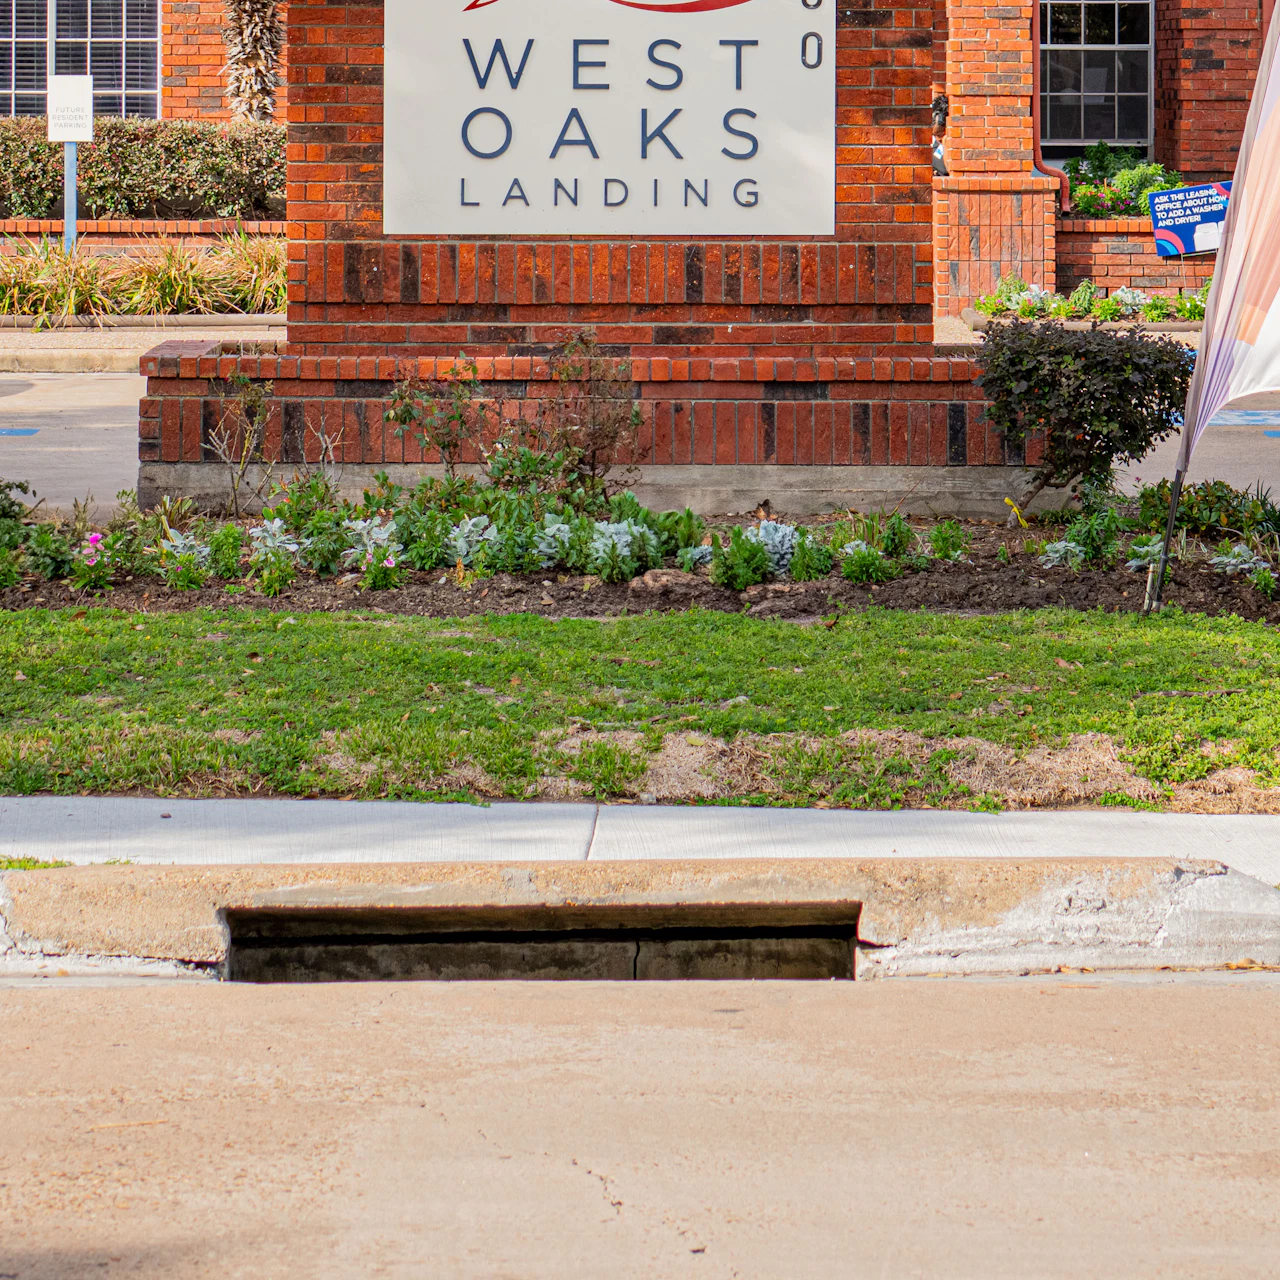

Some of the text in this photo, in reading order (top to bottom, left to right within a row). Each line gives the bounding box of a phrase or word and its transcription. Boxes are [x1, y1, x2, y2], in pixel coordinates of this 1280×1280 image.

[462, 38, 759, 91] WEST
[461, 106, 759, 160] OAKS
[460, 177, 759, 207] LANDING
[1154, 188, 1217, 204] ASK THE LEASING
[1155, 195, 1227, 211] OFFICE ABOUT HOW
[1168, 210, 1184, 218] ADD
[1192, 203, 1224, 214] WASHER
[1158, 219, 1174, 227] AND
